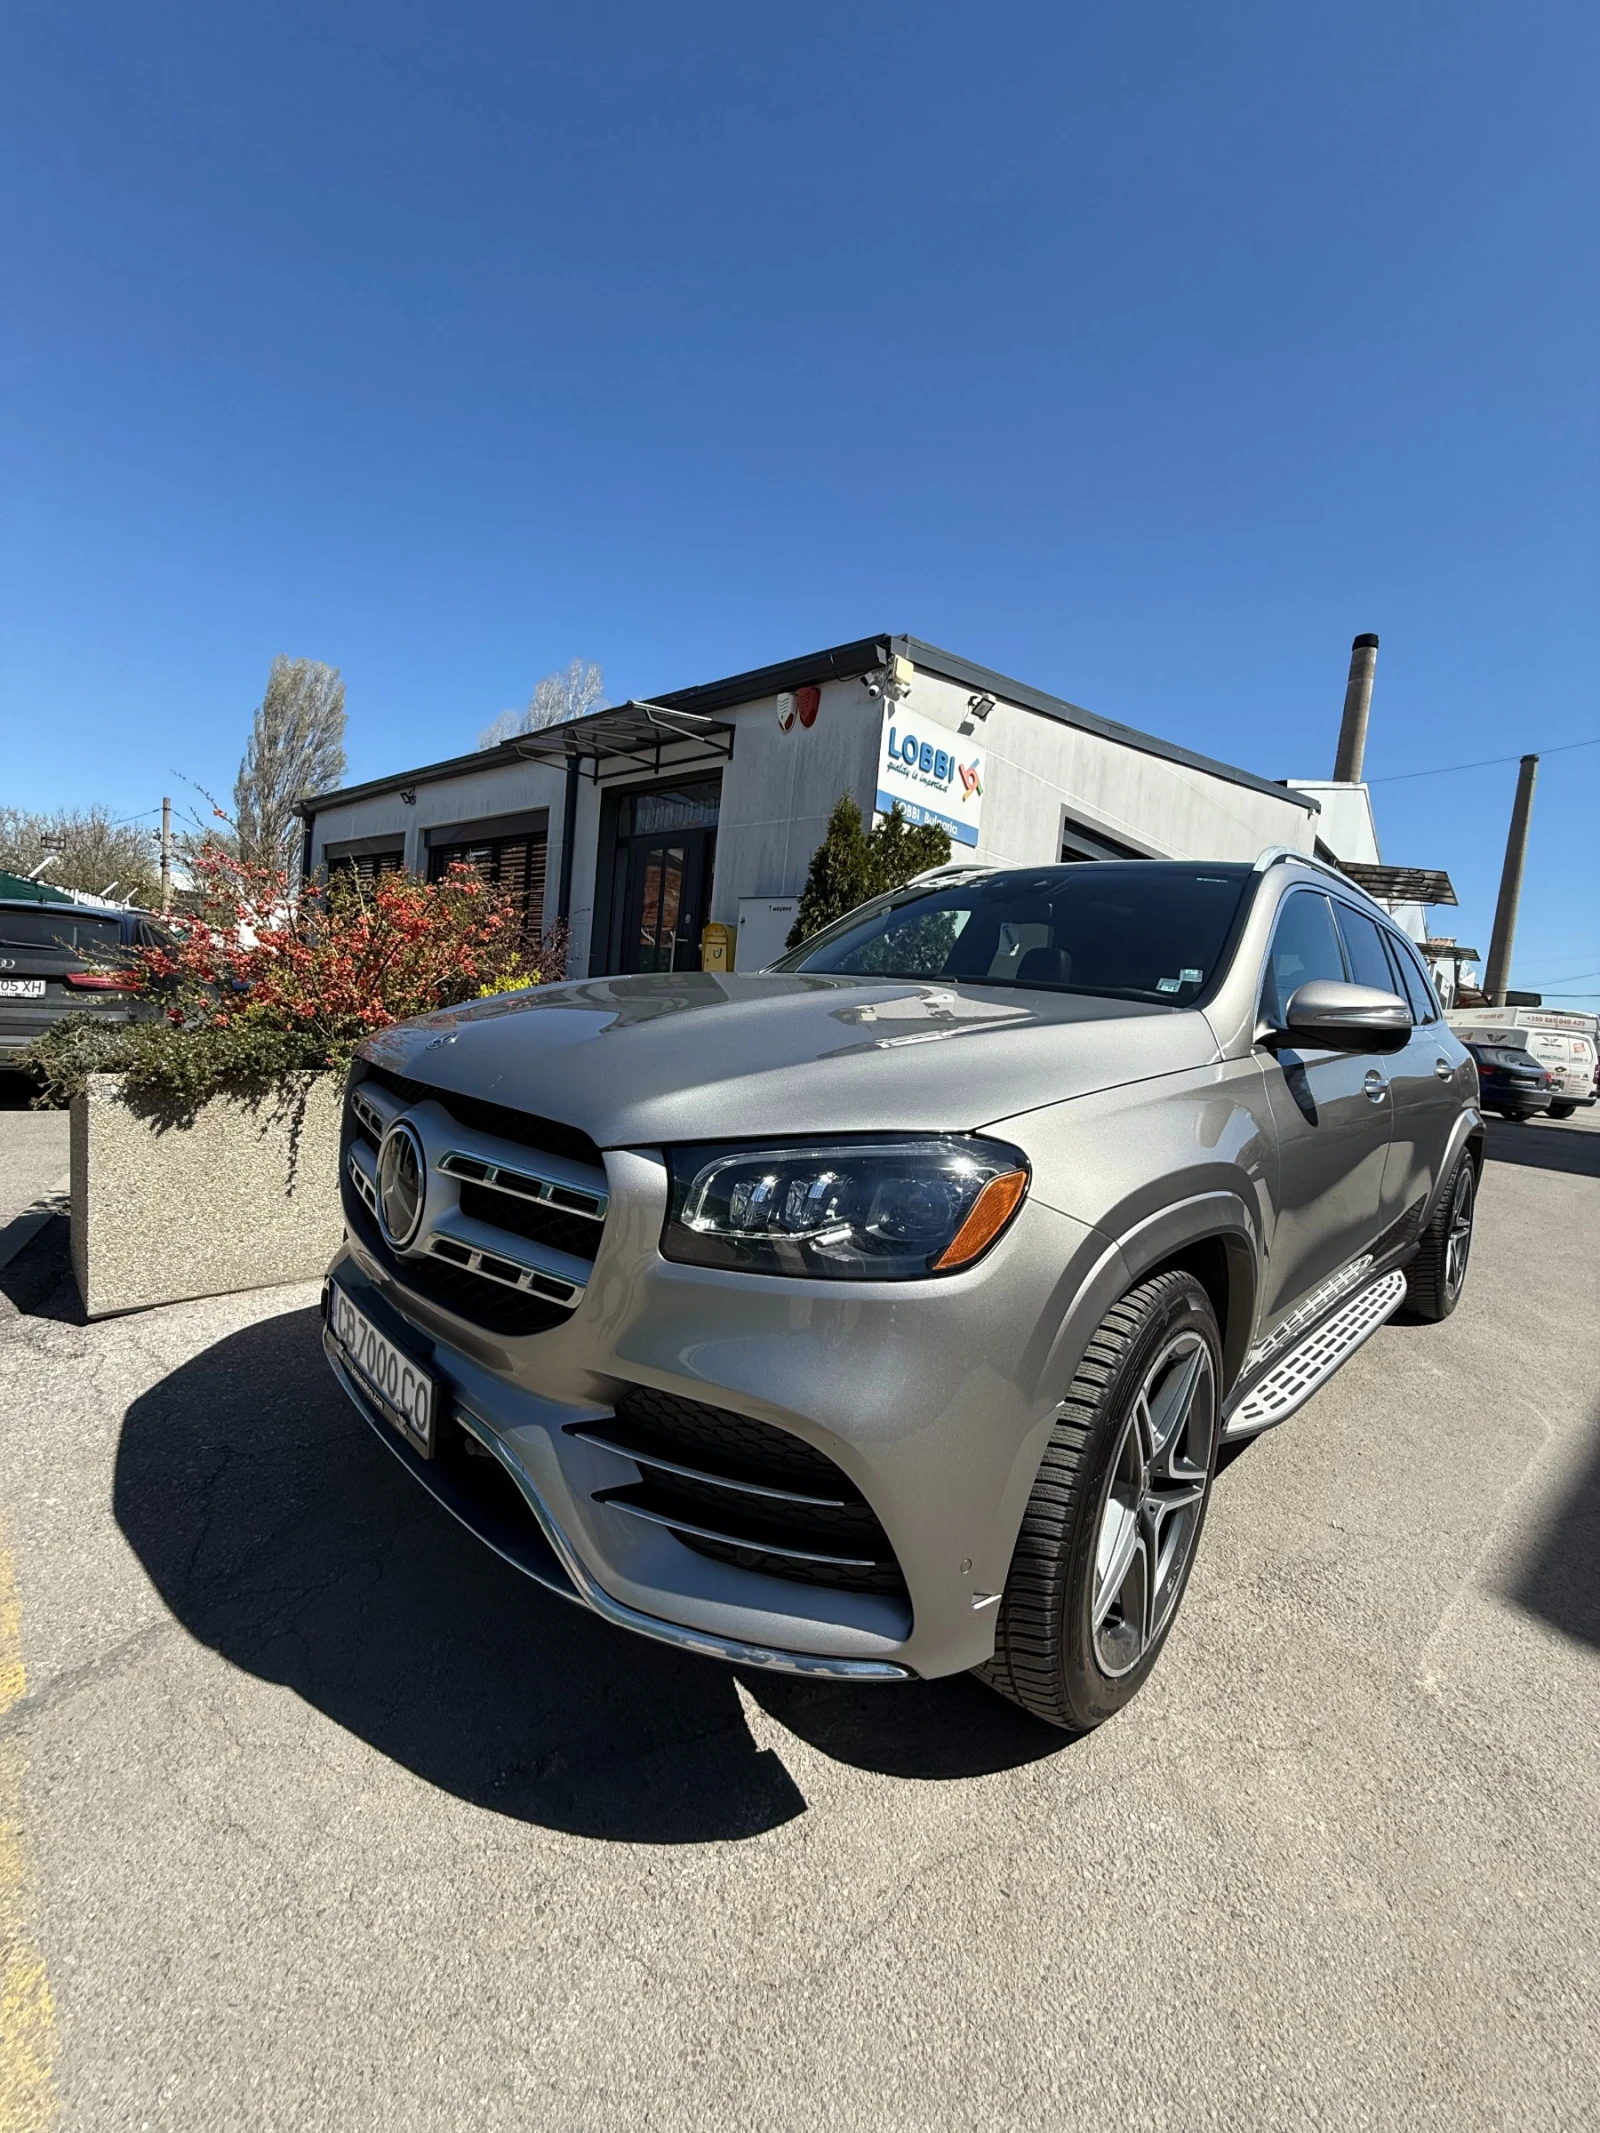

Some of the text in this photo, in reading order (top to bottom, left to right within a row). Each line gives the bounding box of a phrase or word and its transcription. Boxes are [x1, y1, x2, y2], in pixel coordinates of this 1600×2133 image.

[888, 727, 955, 783] LOBBI
[887, 761, 950, 794] quality is important
[896, 800, 920, 820] OBBI
[22, 980, 42, 993] XH
[339, 1297, 428, 1433] CB 7000 CO
